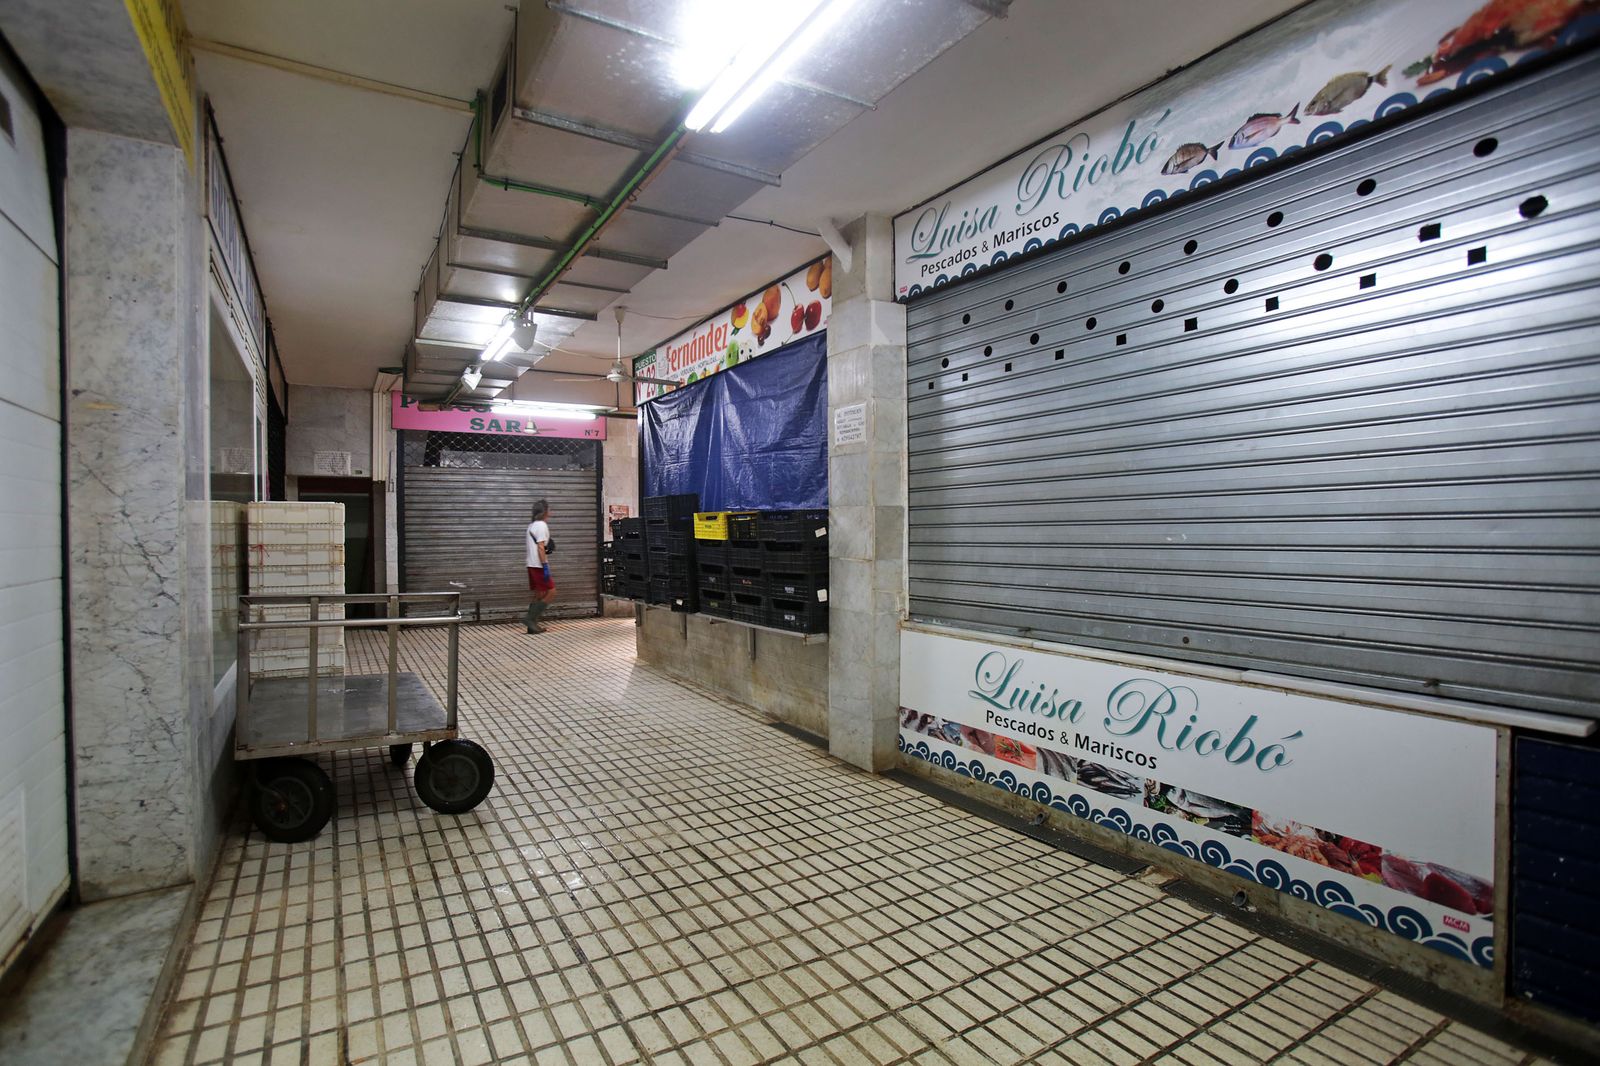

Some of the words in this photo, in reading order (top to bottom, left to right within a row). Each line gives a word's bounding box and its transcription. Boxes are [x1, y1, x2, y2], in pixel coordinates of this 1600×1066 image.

[905, 200, 999, 263] Luisa
[1015, 108, 1171, 216] Riobó
[920, 246, 976, 278] Pescados
[981, 241, 989, 252] &
[993, 212, 1059, 249] Mariscos
[635, 353, 657, 371] PUESTO
[666, 322, 729, 374] Fernández
[646, 364, 656, 399] 23
[469, 417, 540, 434] SAR
[968, 651, 1085, 724] Luisa
[1103, 678, 1304, 772] Riobó
[986, 710, 1055, 742] Pescados
[1060, 732, 1070, 744] &
[1075, 733, 1158, 770] Mariscos
